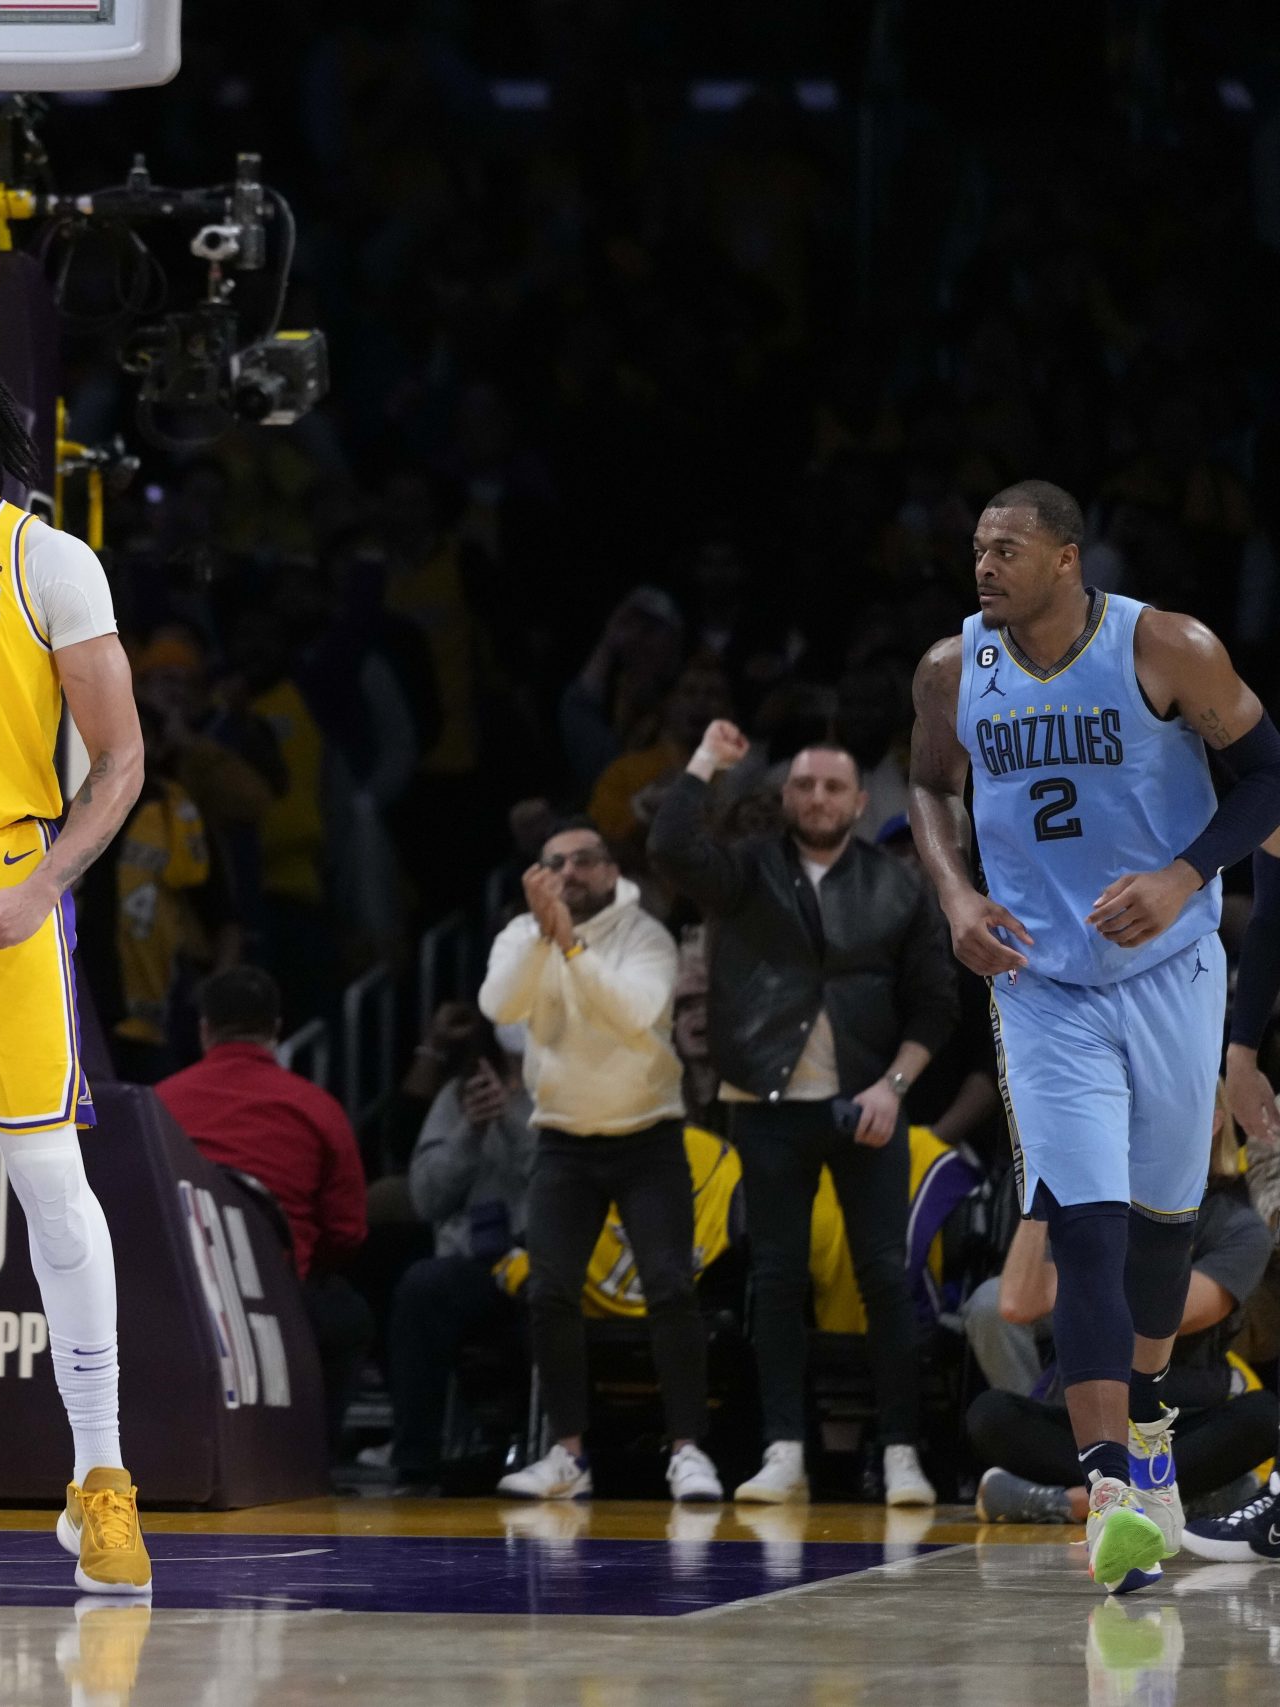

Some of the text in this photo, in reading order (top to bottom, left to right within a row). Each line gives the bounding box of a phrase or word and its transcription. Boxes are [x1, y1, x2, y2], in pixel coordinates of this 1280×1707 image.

[980, 647, 994, 666] 6
[992, 704, 1099, 722] MEMPHIS
[976, 708, 1124, 777] GRIZZLIES
[1029, 777, 1082, 842] 2
